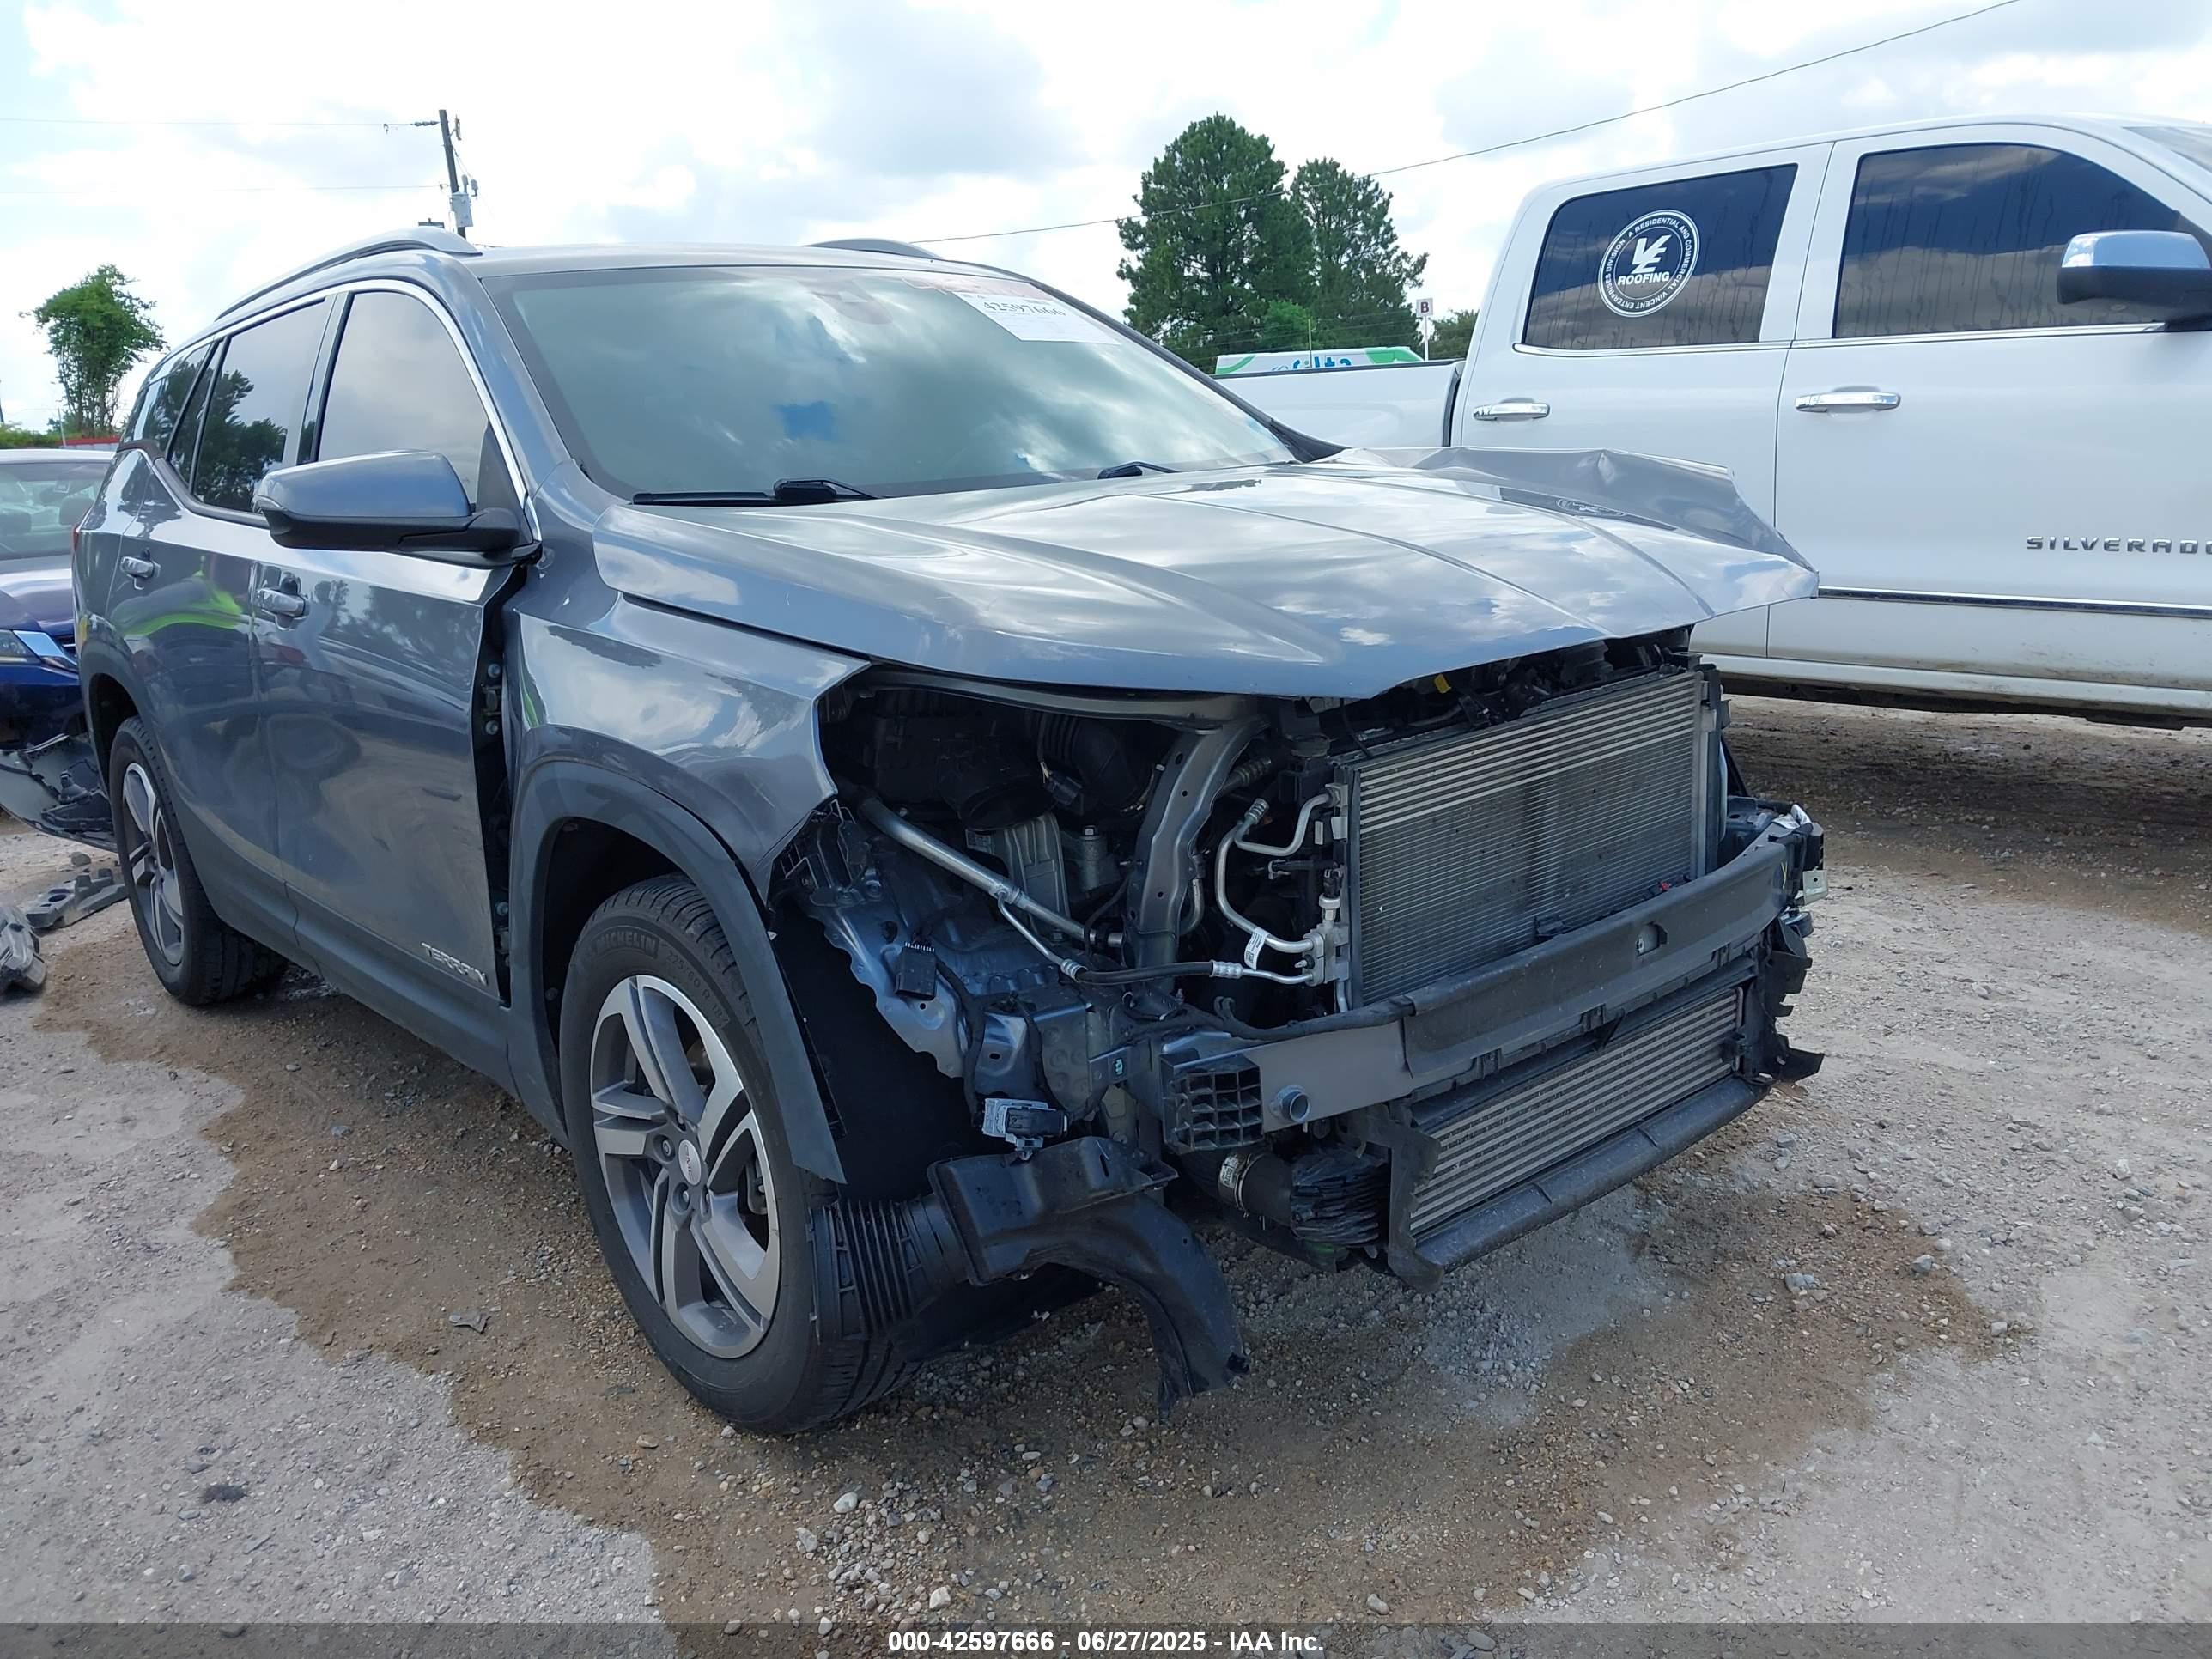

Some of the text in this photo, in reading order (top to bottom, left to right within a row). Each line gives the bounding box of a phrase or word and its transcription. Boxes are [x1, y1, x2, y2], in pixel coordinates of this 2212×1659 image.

[1634, 217, 1680, 233] RESIDENTIAL
[1678, 225, 1690, 240] AND
[1605, 239, 1626, 272] DIVISION
[1667, 239, 1692, 291] COMMERCIAL
[1617, 271, 1670, 286] ROOFING
[1605, 273, 1634, 310] ENTERPRISES
[1635, 291, 1668, 310] VINCENT
[1420, 301, 1430, 313] B
[595, 929, 658, 957] MICHELIN
[421, 941, 489, 987] TERRAIN
